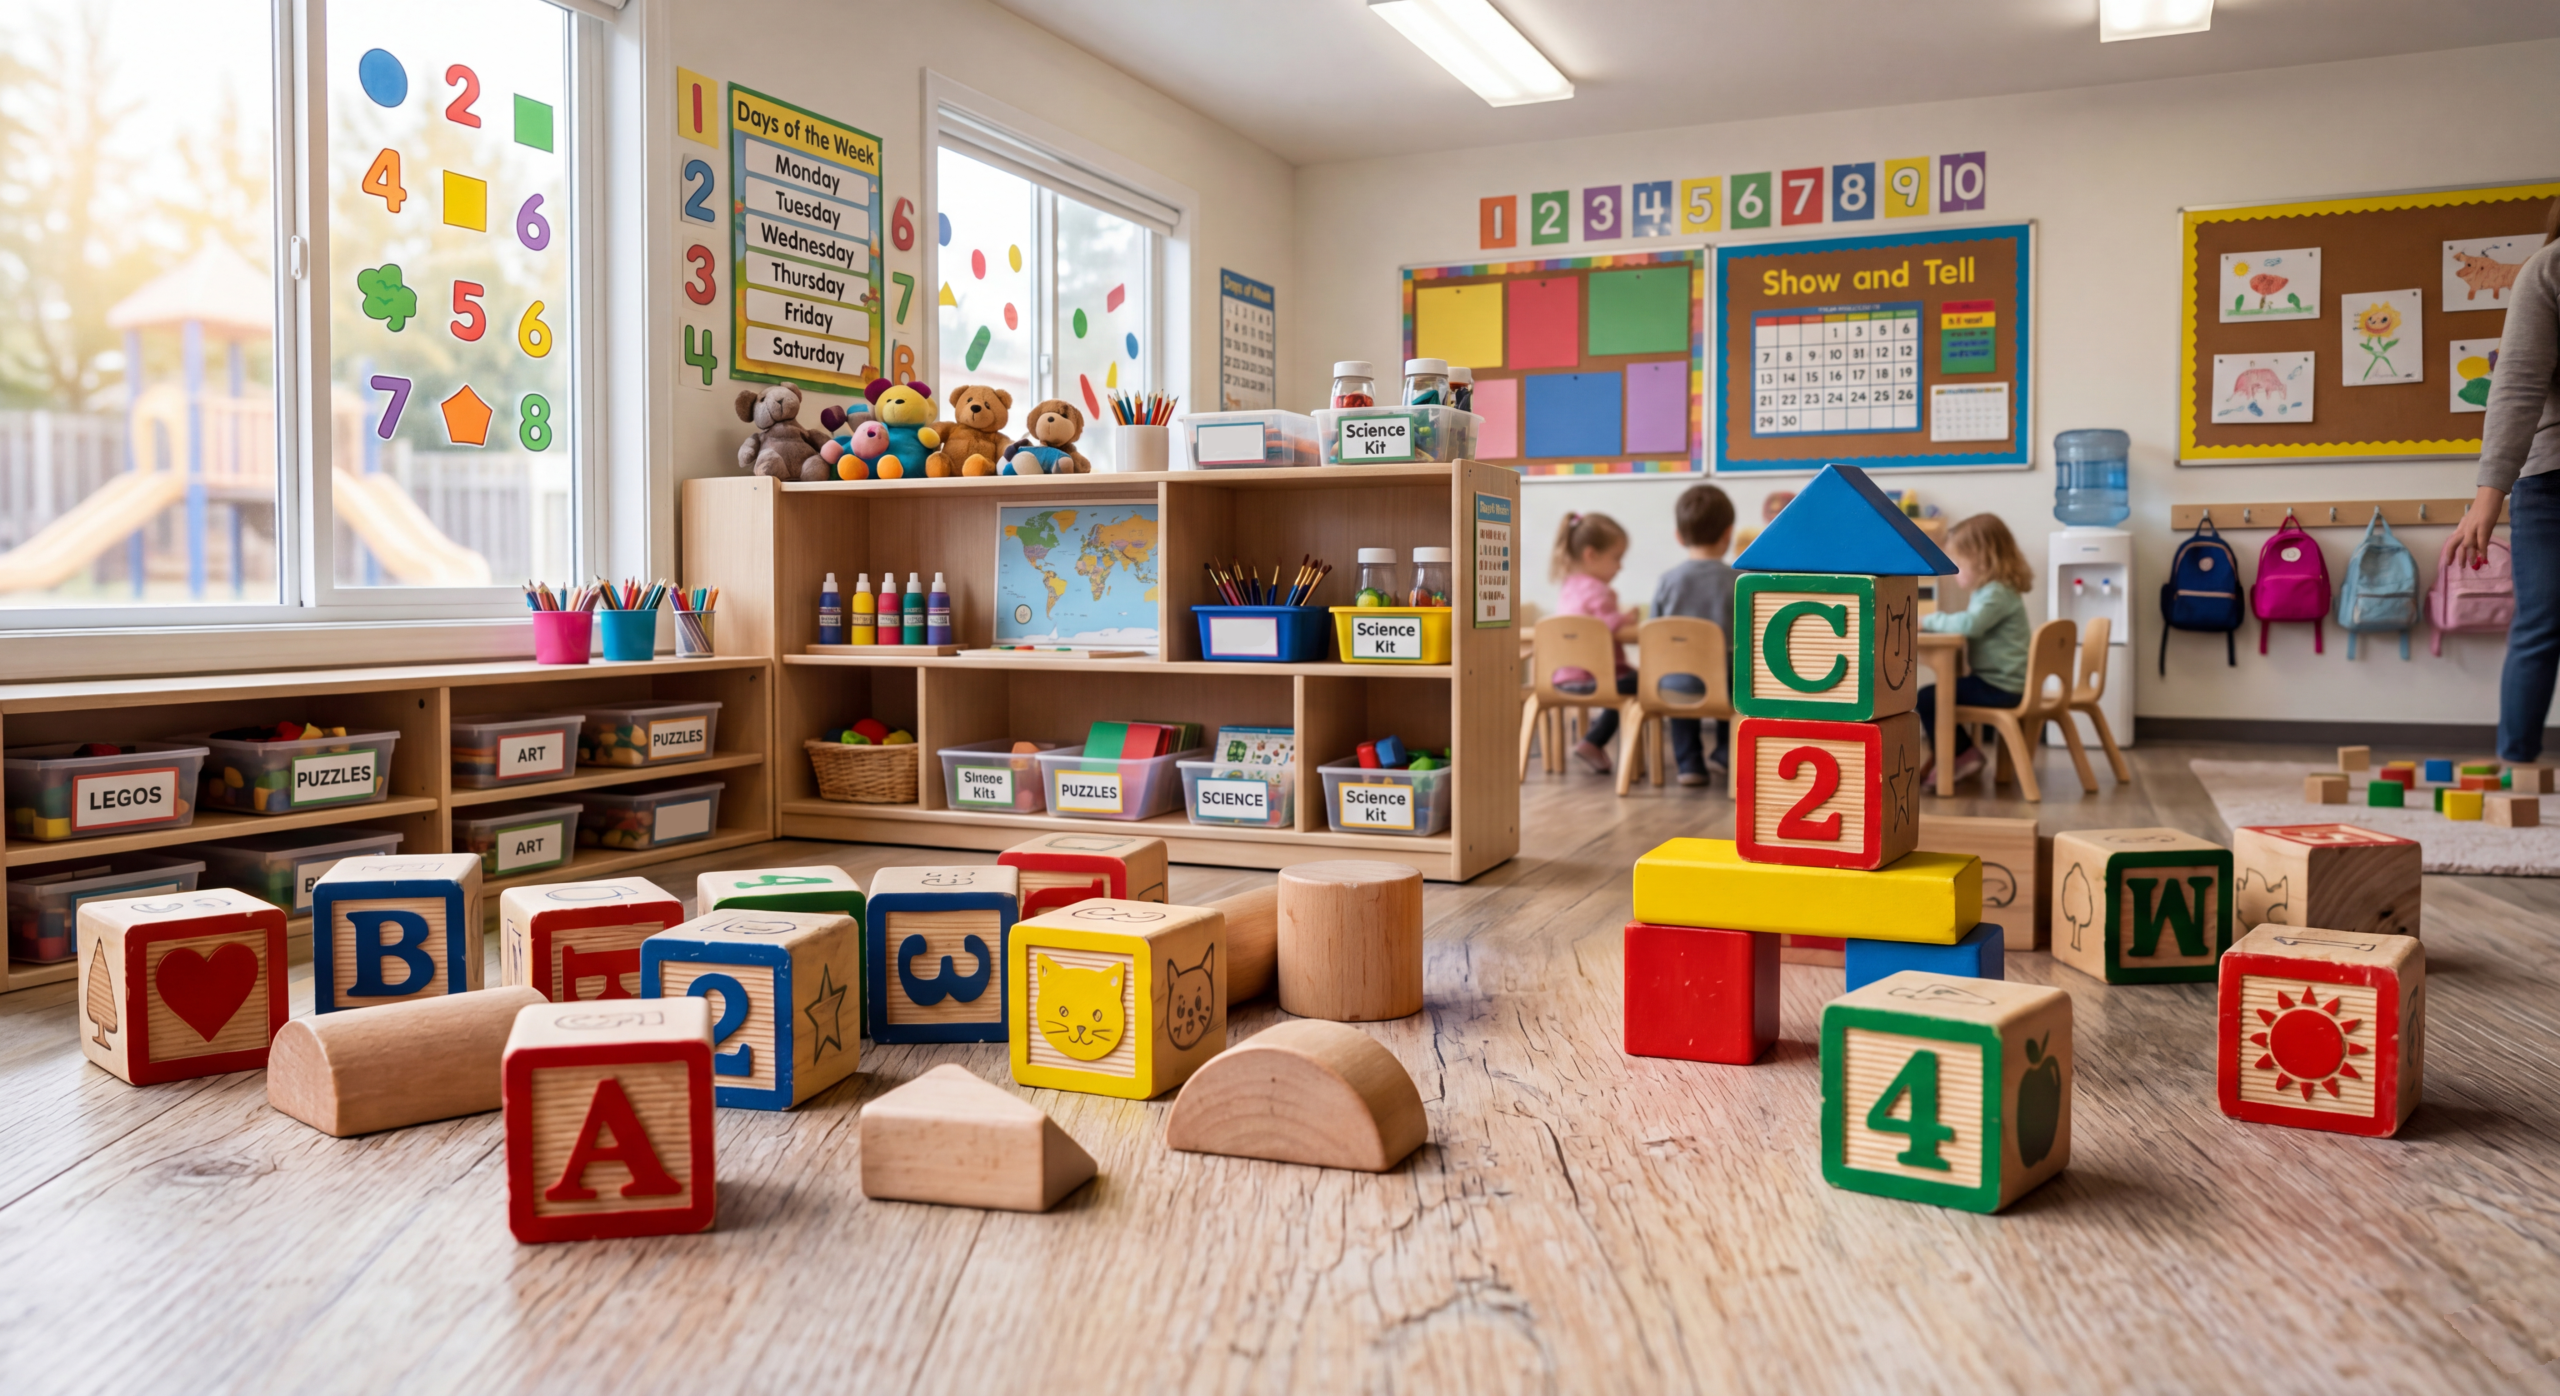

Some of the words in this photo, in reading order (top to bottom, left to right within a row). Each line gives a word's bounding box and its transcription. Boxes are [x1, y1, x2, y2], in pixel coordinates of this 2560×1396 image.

[445, 63, 481, 128] 2
[737, 100, 779, 135] Days
[784, 119, 801, 141] of
[805, 124, 830, 151] the
[834, 134, 875, 166] Week
[362, 147, 407, 213] 4
[684, 159, 715, 223] 2
[775, 154, 840, 196] Monday
[776, 190, 841, 231] Tuesday
[1539, 200, 1561, 235] 2
[1590, 195, 1614, 231] 3
[1639, 190, 1664, 224] 4
[1687, 186, 1713, 224] 5
[1738, 183, 1763, 219] 6
[1789, 178, 1815, 215] 7
[1840, 173, 1867, 212] 8
[1892, 166, 1921, 208] 9
[1943, 162, 1984, 203] 10
[516, 193, 551, 251] 6
[891, 195, 915, 251] 6
[761, 222, 854, 269] Wednesday
[685, 244, 716, 305] 3
[772, 262, 845, 302] Thursday
[1763, 268, 1841, 296] Show
[1853, 261, 1909, 290] and
[1923, 256, 1975, 286] Tell
[450, 280, 487, 342] 5
[784, 302, 833, 334] Friday
[892, 271, 915, 325] 7
[518, 300, 553, 358] 6
[1856, 326, 1862, 337] 3
[1879, 325, 1887, 336] 5
[1903, 324, 1910, 334] 6
[684, 324, 718, 386] 4
[773, 337, 844, 372] Saturday
[1763, 353, 1770, 363] 7
[1785, 352, 1792, 362] 8
[1808, 351, 1816, 361] 9
[1830, 349, 1842, 360] 10
[1876, 347, 1889, 358] 12
[1900, 346, 1912, 356] 12
[1761, 374, 1773, 384] 13
[1783, 373, 1795, 383] 14
[1806, 372, 1818, 382] 15
[1830, 371, 1842, 381] 16
[1853, 370, 1865, 380] 17
[1876, 368, 1888, 379] 18
[1900, 367, 1912, 378] 19
[370, 374, 412, 439] 7
[1760, 395, 1772, 406] 21
[1782, 394, 1796, 405] 22
[1805, 394, 1820, 404] 23
[1827, 393, 1843, 403] 24
[1851, 392, 1866, 403] 24
[1874, 391, 1889, 402] 25
[1898, 390, 1913, 400] 26
[519, 393, 553, 452] 8
[1346, 423, 1406, 439] Science
[1760, 417, 1773, 427] 29
[1782, 416, 1797, 426] 30
[1365, 440, 1386, 455] Kit
[1357, 622, 1416, 637] Science
[1375, 640, 1396, 654] Kit
[1762, 601, 1847, 693] C
[517, 746, 546, 763] ART
[653, 729, 703, 747] PUZZLES
[297, 765, 371, 789] PUZZLES
[1062, 784, 1118, 799] PUZZLES
[1777, 745, 1841, 841] 2
[89, 786, 162, 811] LEGOS
[1202, 791, 1264, 807] SCIENCE
[1346, 790, 1406, 806] Science
[515, 838, 544, 856] ART
[346, 910, 434, 996] B
[686, 973, 752, 1077] 2
[1866, 1049, 1955, 1171] 4
[544, 1077, 683, 1201] A
